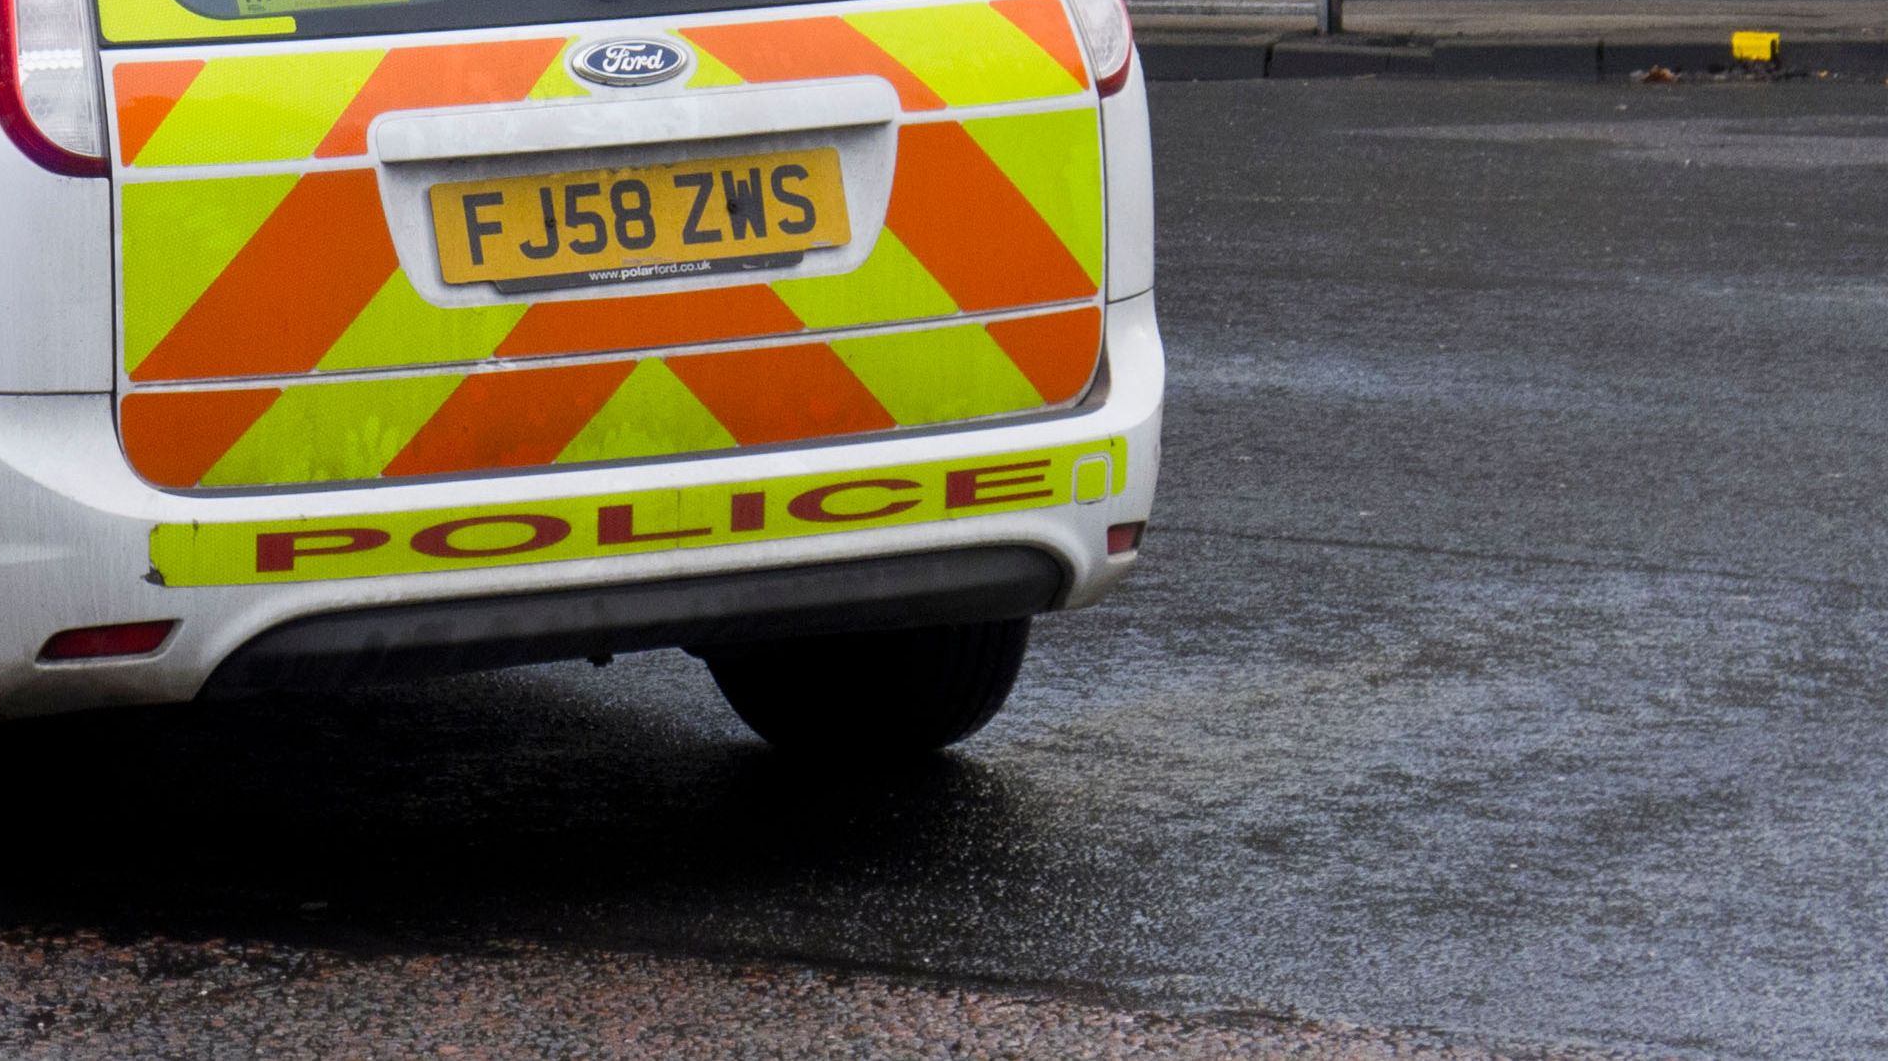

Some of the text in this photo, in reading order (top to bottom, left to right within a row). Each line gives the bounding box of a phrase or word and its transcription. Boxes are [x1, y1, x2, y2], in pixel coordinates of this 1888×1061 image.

[603, 44, 664, 72] Ford
[462, 164, 817, 266] FJ58 ZWS
[589, 259, 712, 281] www.polarford.co.uk
[255, 459, 1053, 573] POLICE
